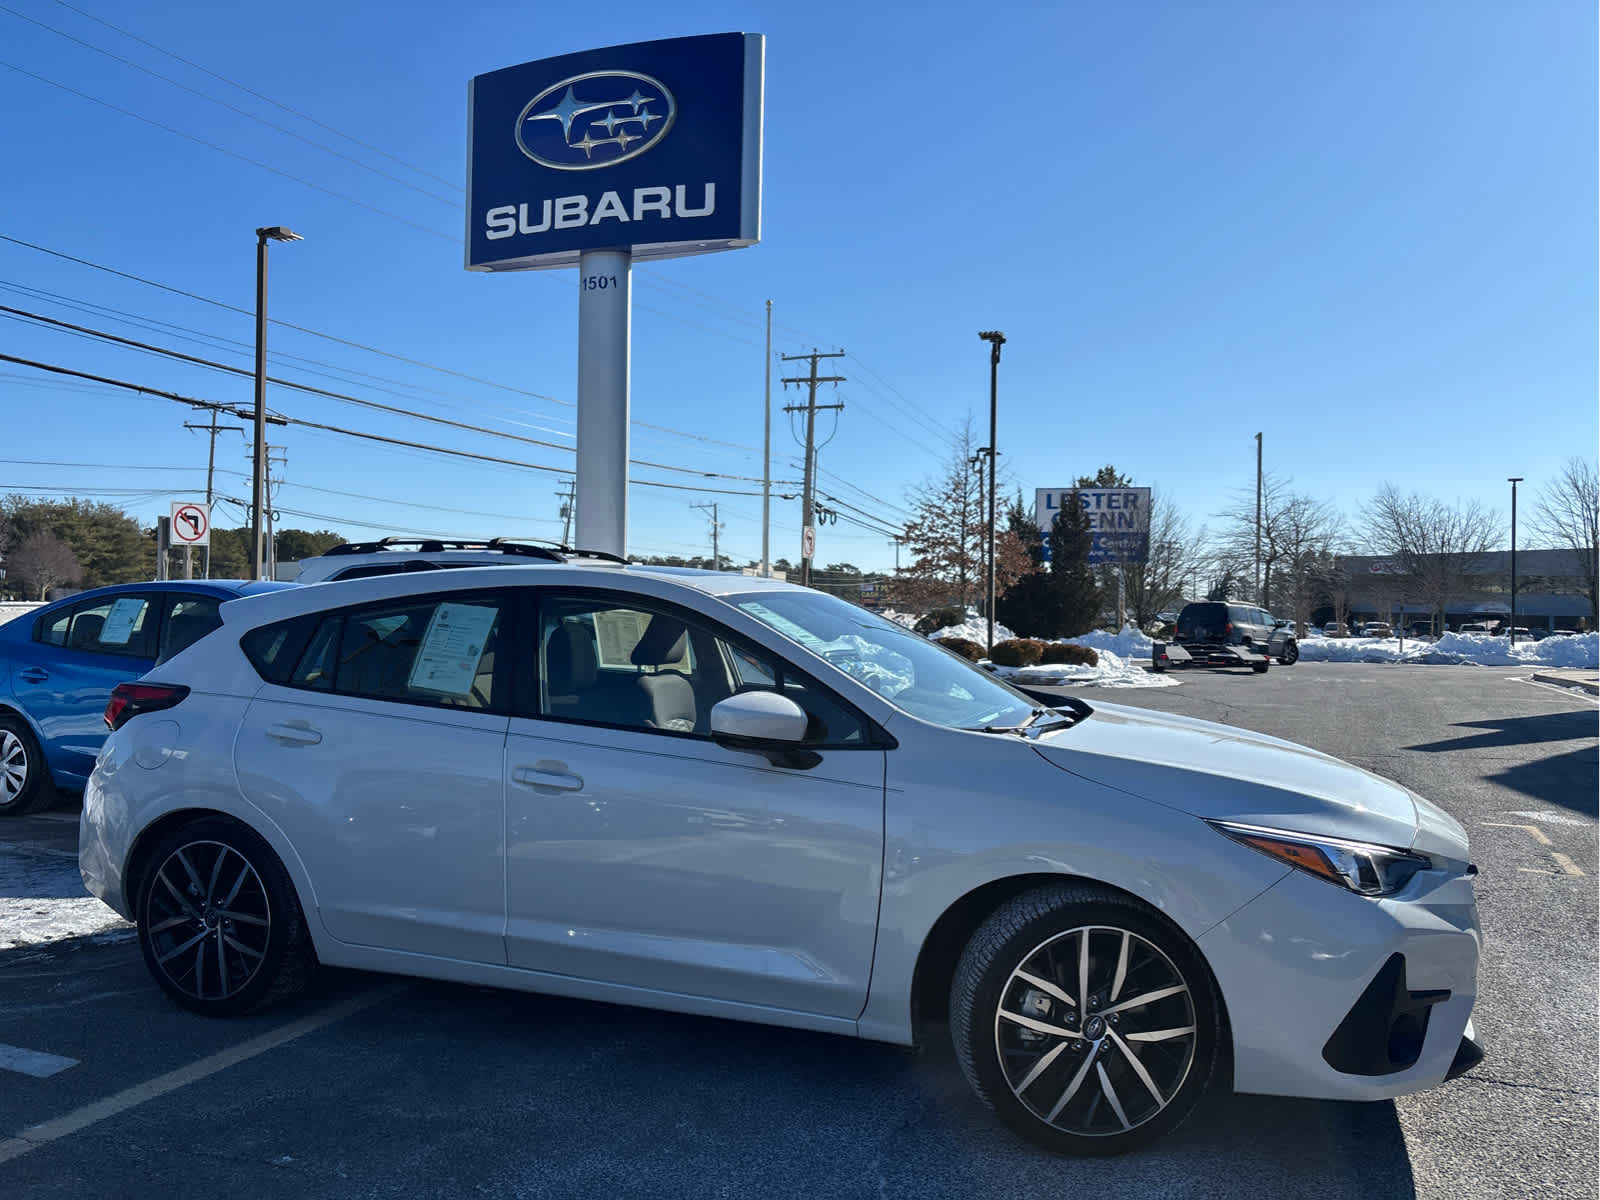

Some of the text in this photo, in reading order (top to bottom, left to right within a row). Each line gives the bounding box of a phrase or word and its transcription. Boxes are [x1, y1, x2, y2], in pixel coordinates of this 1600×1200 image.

[485, 182, 716, 241] SUBARU
[583, 276, 617, 291] 1501
[1046, 493, 1138, 509] LSTER
[1051, 512, 1136, 528] ENN
